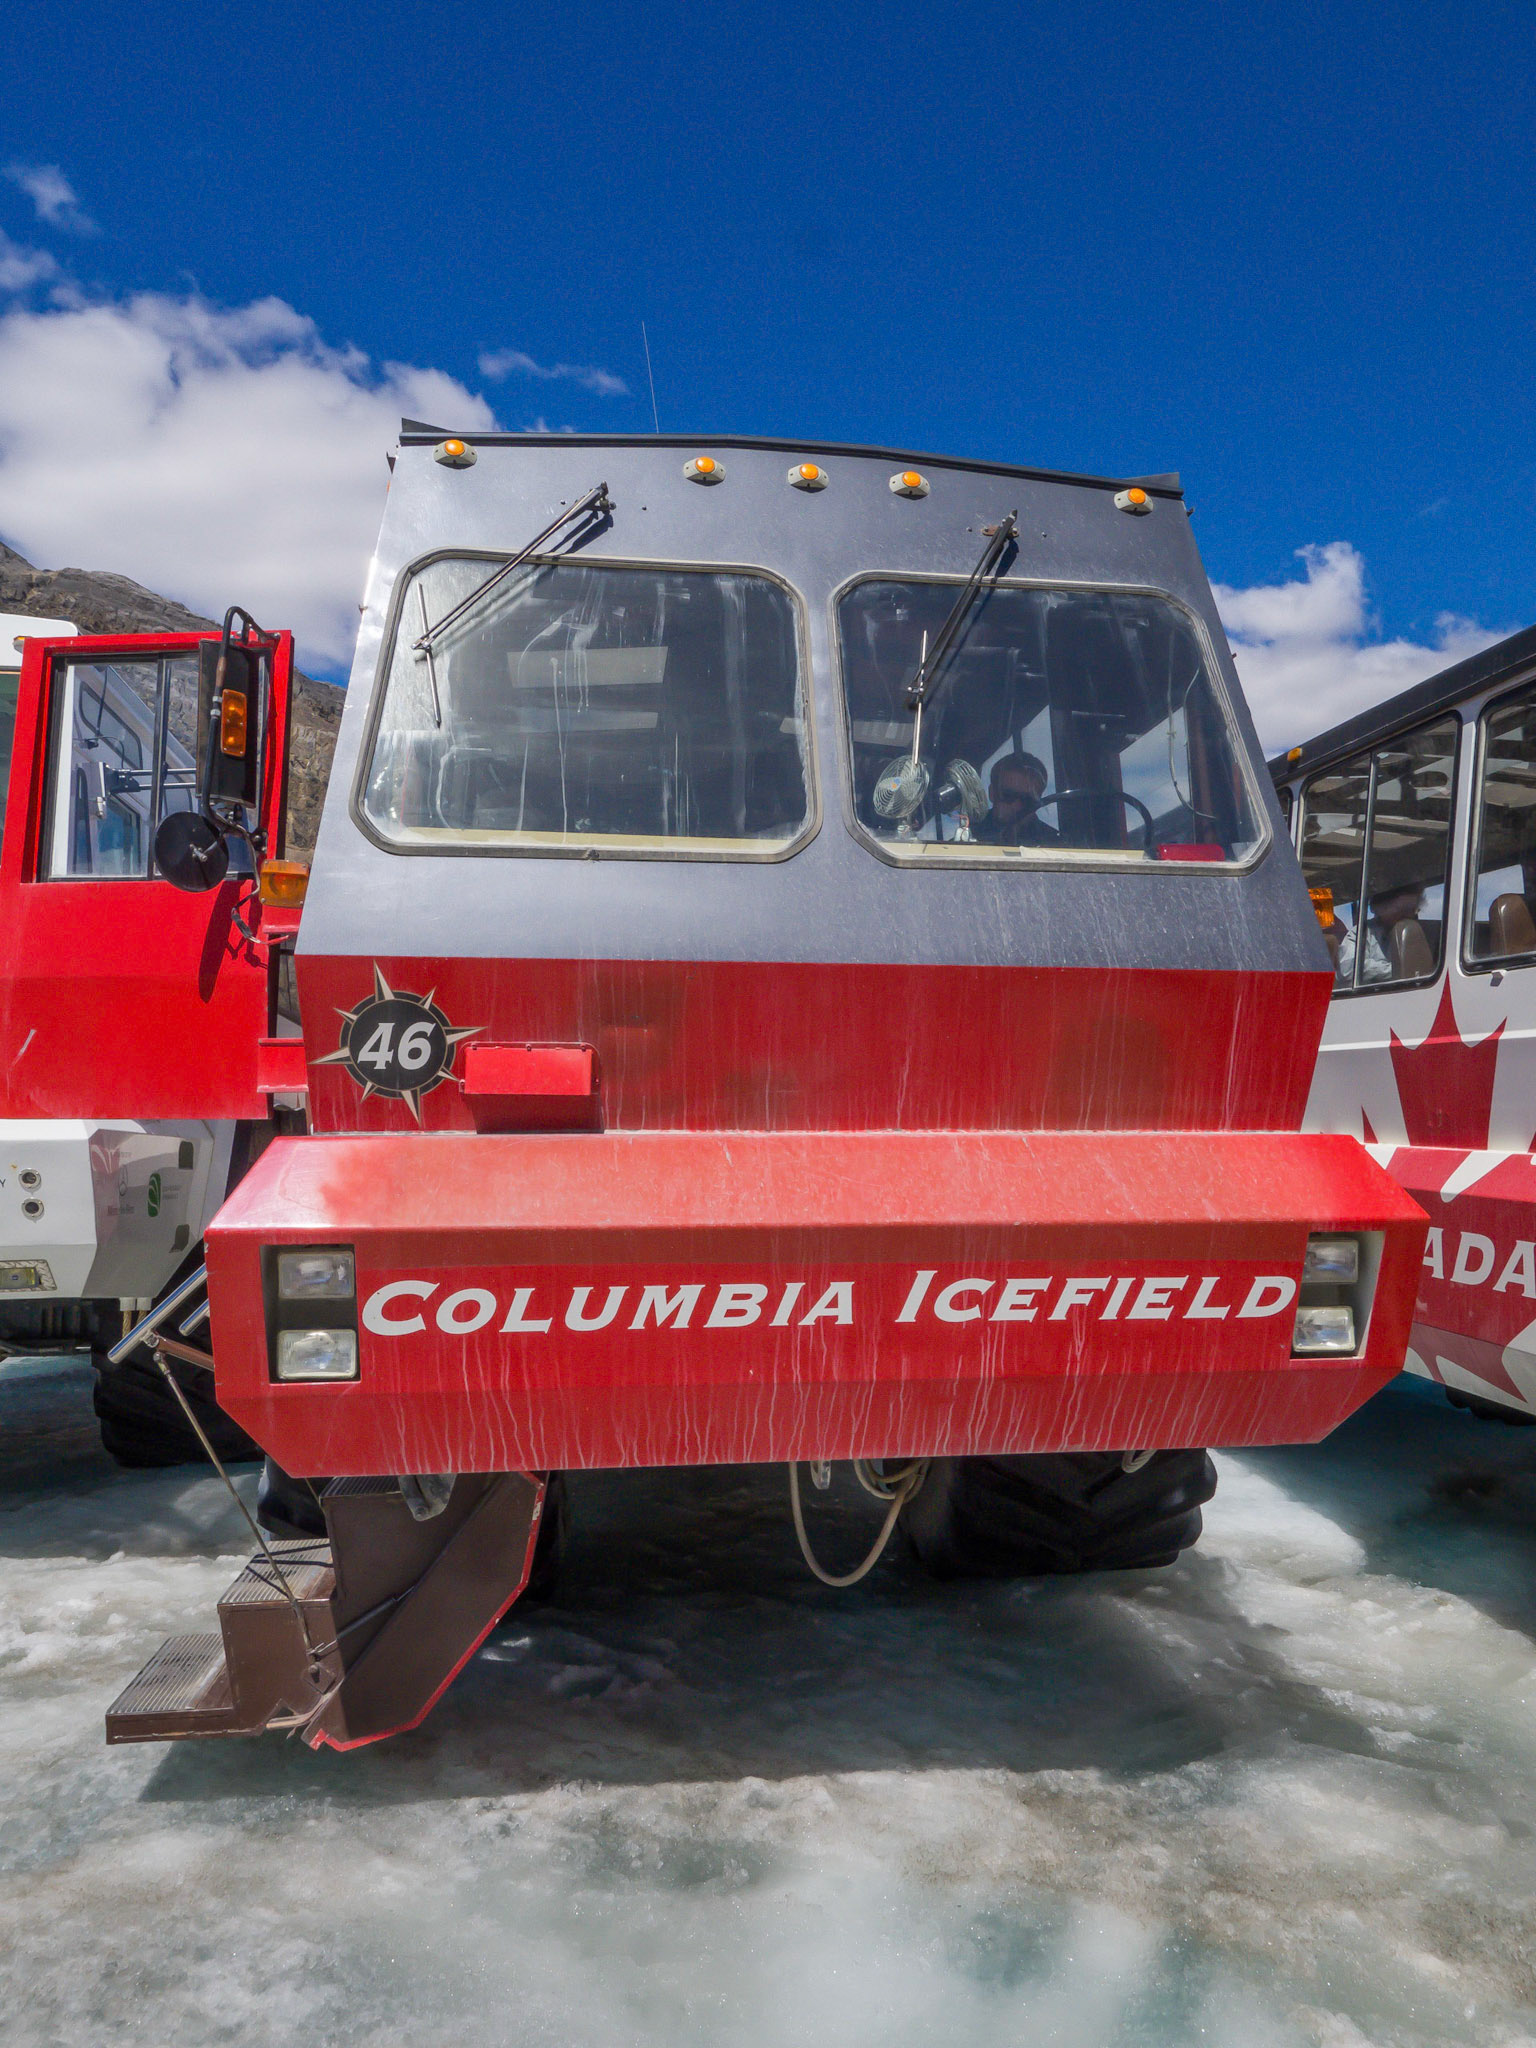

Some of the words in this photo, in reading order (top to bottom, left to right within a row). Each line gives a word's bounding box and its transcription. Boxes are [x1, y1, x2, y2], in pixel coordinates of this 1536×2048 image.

[357, 1022, 436, 1070] 46
[361, 1279, 855, 1336] COLUMBIA
[895, 1270, 1297, 1323] ICEFIELD
